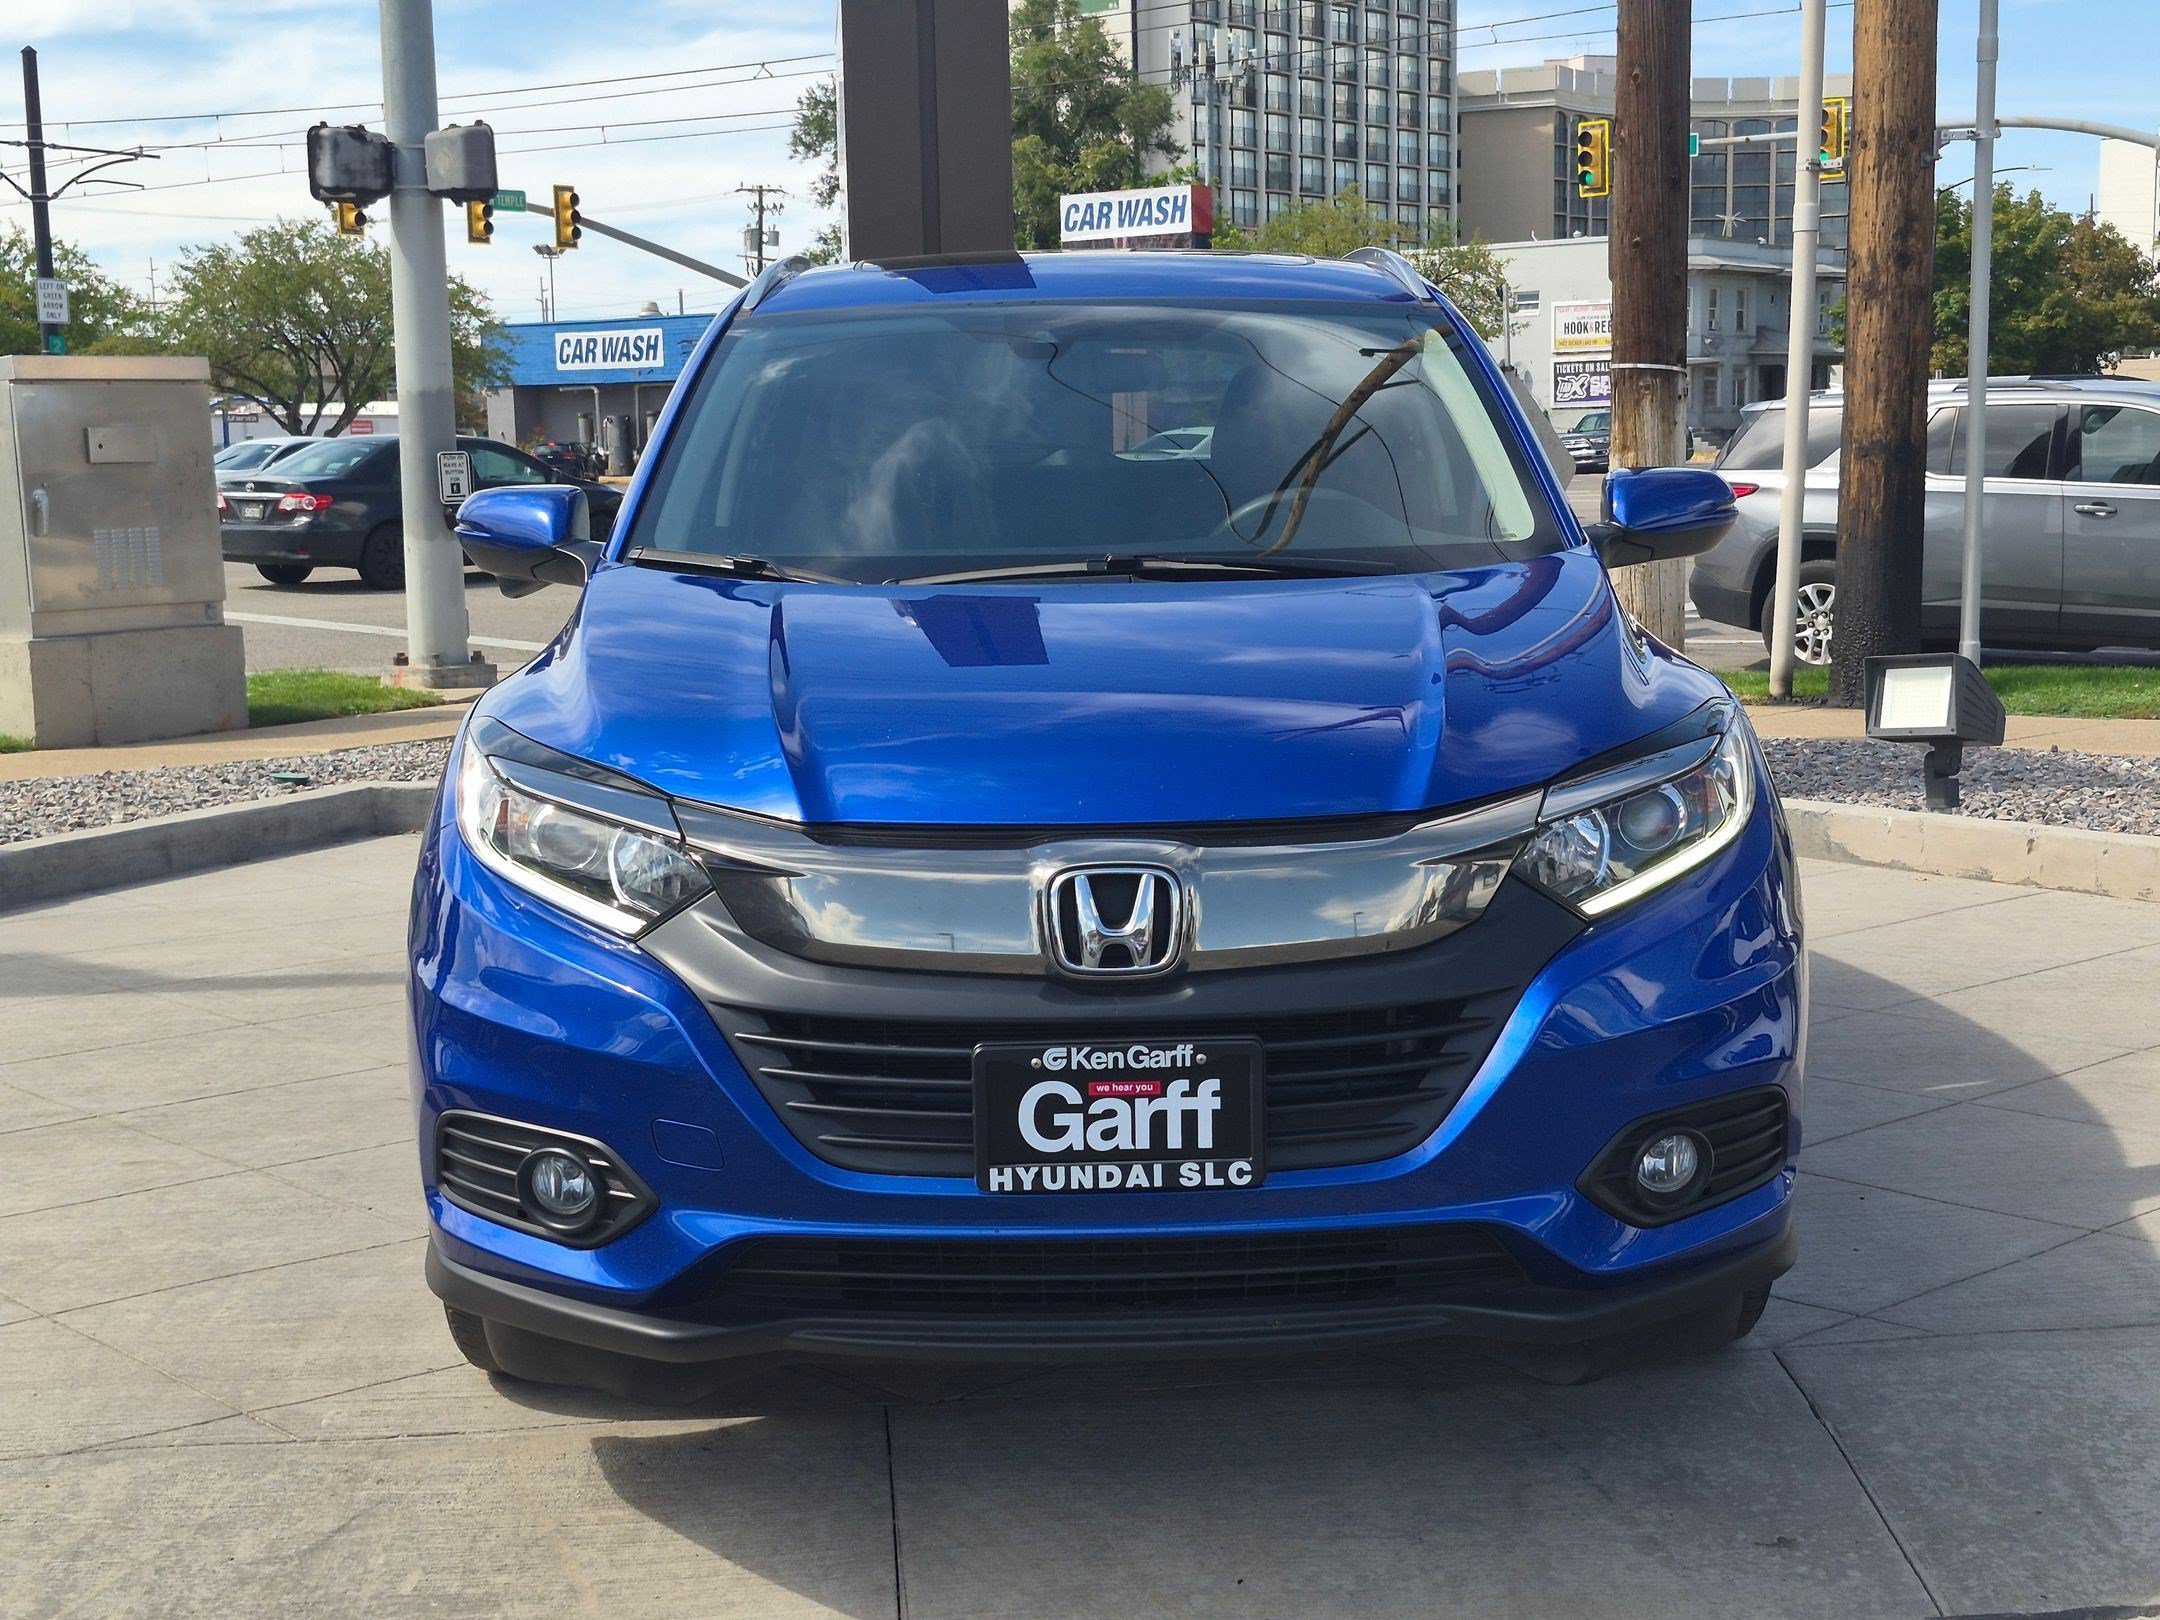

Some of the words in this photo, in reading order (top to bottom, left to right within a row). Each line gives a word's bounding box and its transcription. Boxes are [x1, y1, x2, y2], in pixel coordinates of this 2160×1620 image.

[496, 194, 525, 208] TEMPLE
[1064, 201, 1113, 233] CAR
[1117, 194, 1188, 229] WASH
[40, 282, 54, 290] LEFT
[56, 282, 65, 290] ON
[43, 292, 63, 300] GREEN
[43, 302, 63, 310] ARROW
[46, 311, 61, 319] ONLY
[53, 340, 62, 353] 2
[559, 338, 599, 365] CAR
[601, 334, 660, 363] WASH
[1556, 363, 1584, 374] TICKETS
[1585, 362, 1595, 373] ON
[1096, 1084, 1110, 1092] we
[1112, 1083, 1134, 1092] hear
[1135, 1083, 1153, 1094] you
[1018, 1078, 1221, 1153] Garff
[989, 1163, 1163, 1192] HYUNDAI
[1179, 1161, 1253, 1187] SLC
